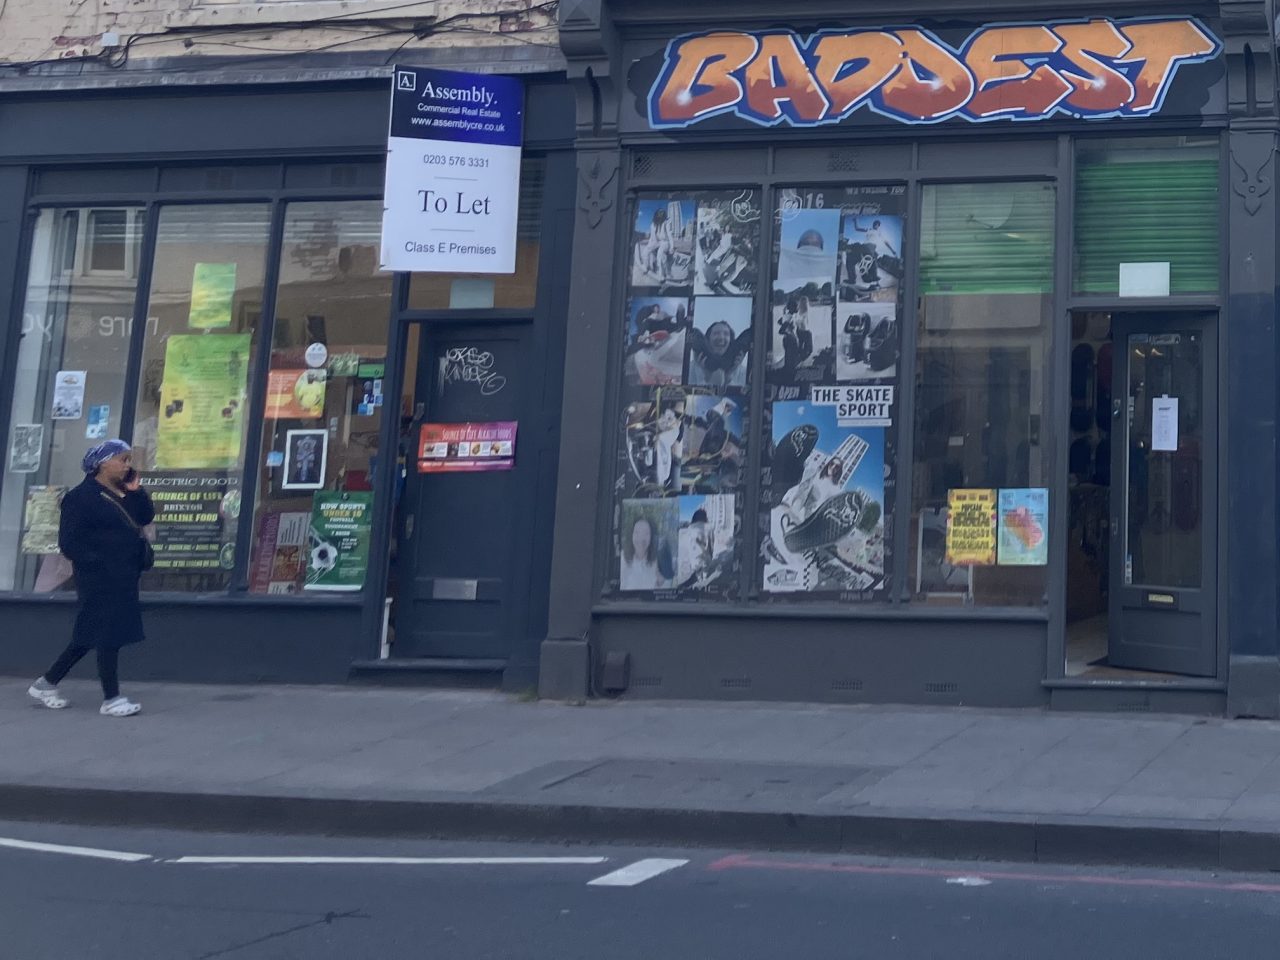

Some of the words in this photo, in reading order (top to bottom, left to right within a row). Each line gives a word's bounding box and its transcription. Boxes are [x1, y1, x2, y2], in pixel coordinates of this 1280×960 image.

[647, 16, 1222, 128] BADDEST
[421, 81, 498, 107] Assembly.
[417, 103, 460, 115] Commercial
[461, 108, 478, 116] Real
[479, 109, 501, 118] Estate
[411, 116, 505, 132] www.assemblycre.co.uk
[423, 154, 446, 165] 0203
[448, 155, 466, 166] 576
[468, 156, 489, 167] 3331
[418, 190, 448, 213] To
[456, 192, 491, 215] Let
[405, 241, 435, 253] Class
[438, 242, 446, 253] E
[450, 243, 496, 255] Premises
[814, 389, 840, 402] THE
[846, 389, 891, 402] SKATE
[838, 403, 885, 417] SPORT
[139, 477, 197, 486] ELECTRIC
[201, 477, 238, 486] FOOD
[151, 491, 188, 501] SOURCE
[190, 492, 201, 500] OF
[163, 503, 203, 512] BRIXTON
[195, 513, 218, 522] FOOD
